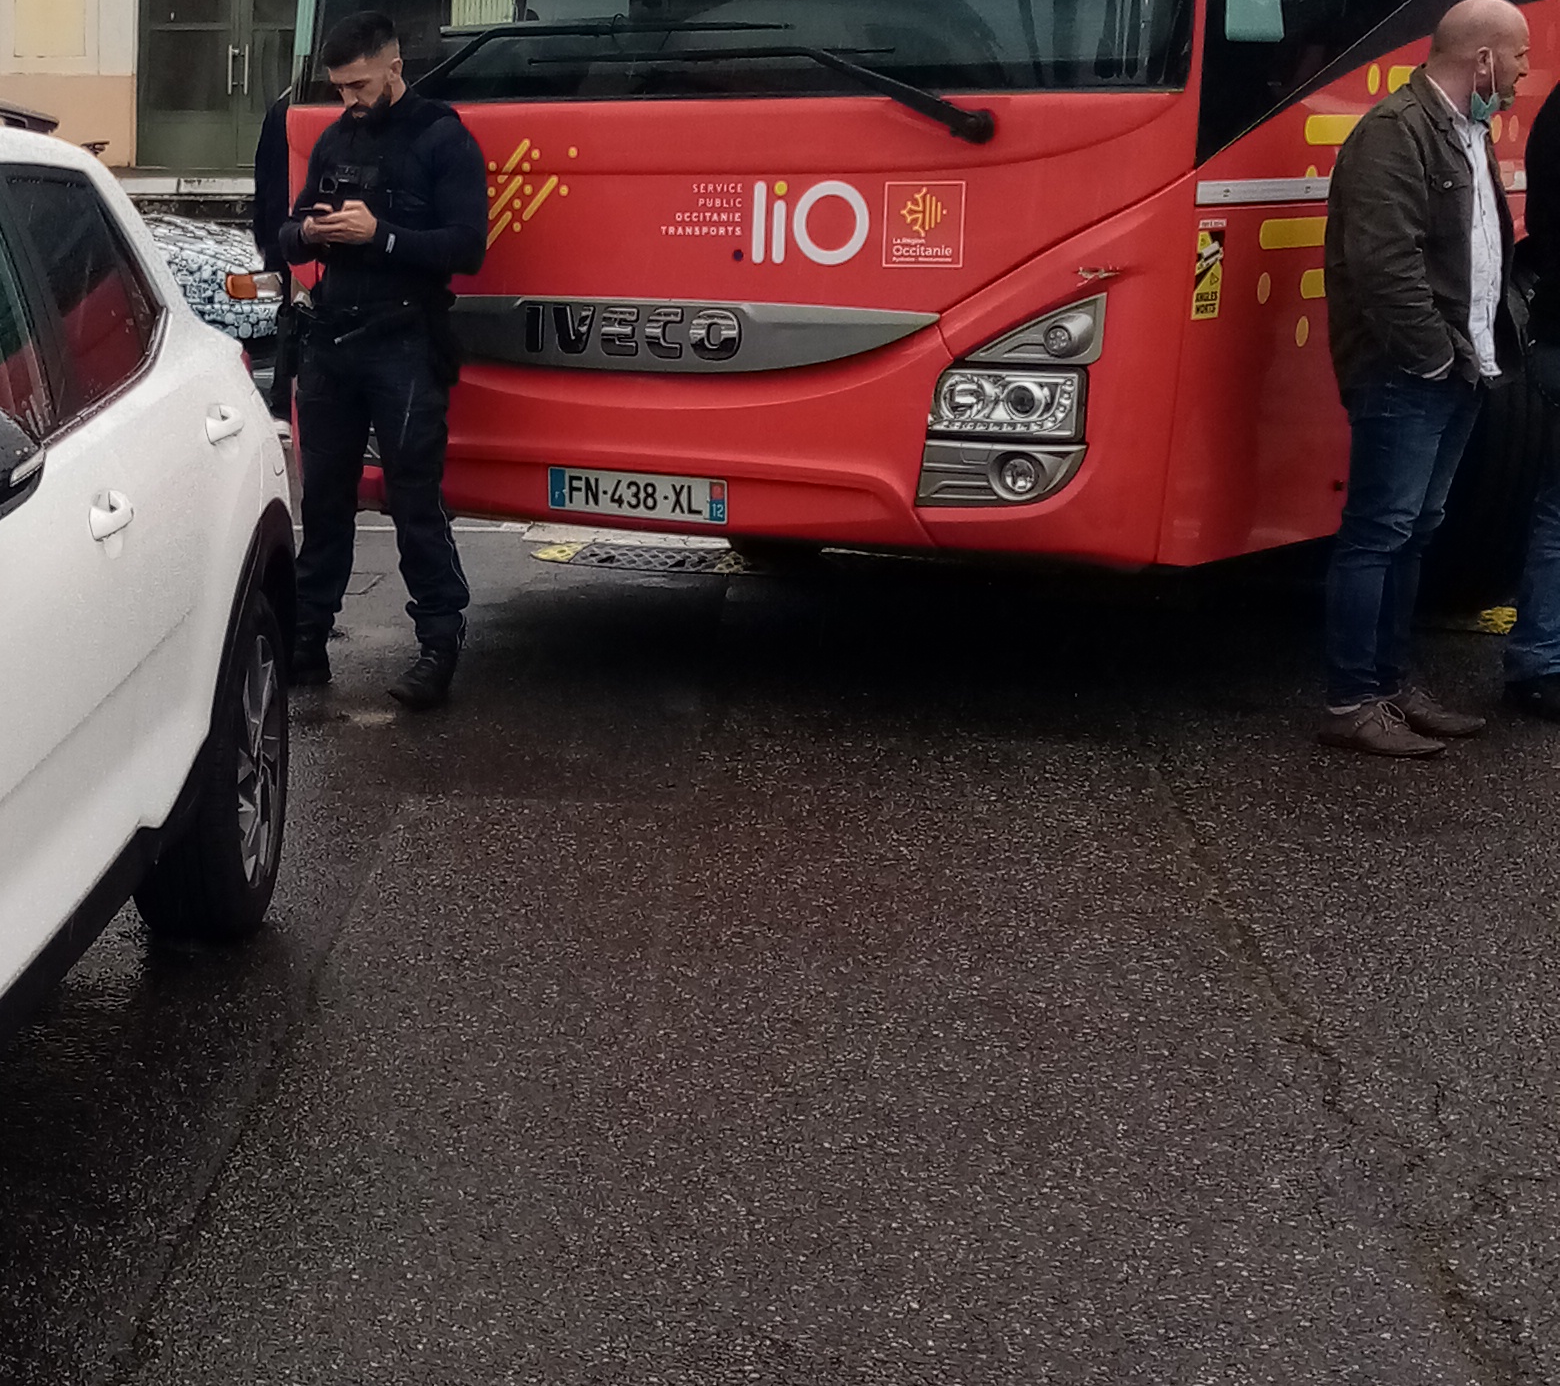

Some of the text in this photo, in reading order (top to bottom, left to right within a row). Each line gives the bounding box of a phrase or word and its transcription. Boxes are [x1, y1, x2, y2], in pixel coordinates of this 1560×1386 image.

[692, 183, 743, 193] SERVICE
[698, 197, 743, 208] PUBLIC
[675, 212, 742, 222] OCCITANIE
[661, 225, 743, 236] TRANSPORTS
[892, 244, 953, 256] Occitanie
[524, 304, 743, 361] IVECO
[567, 475, 703, 516] FN-438-XL
[711, 502, 725, 518] 12
